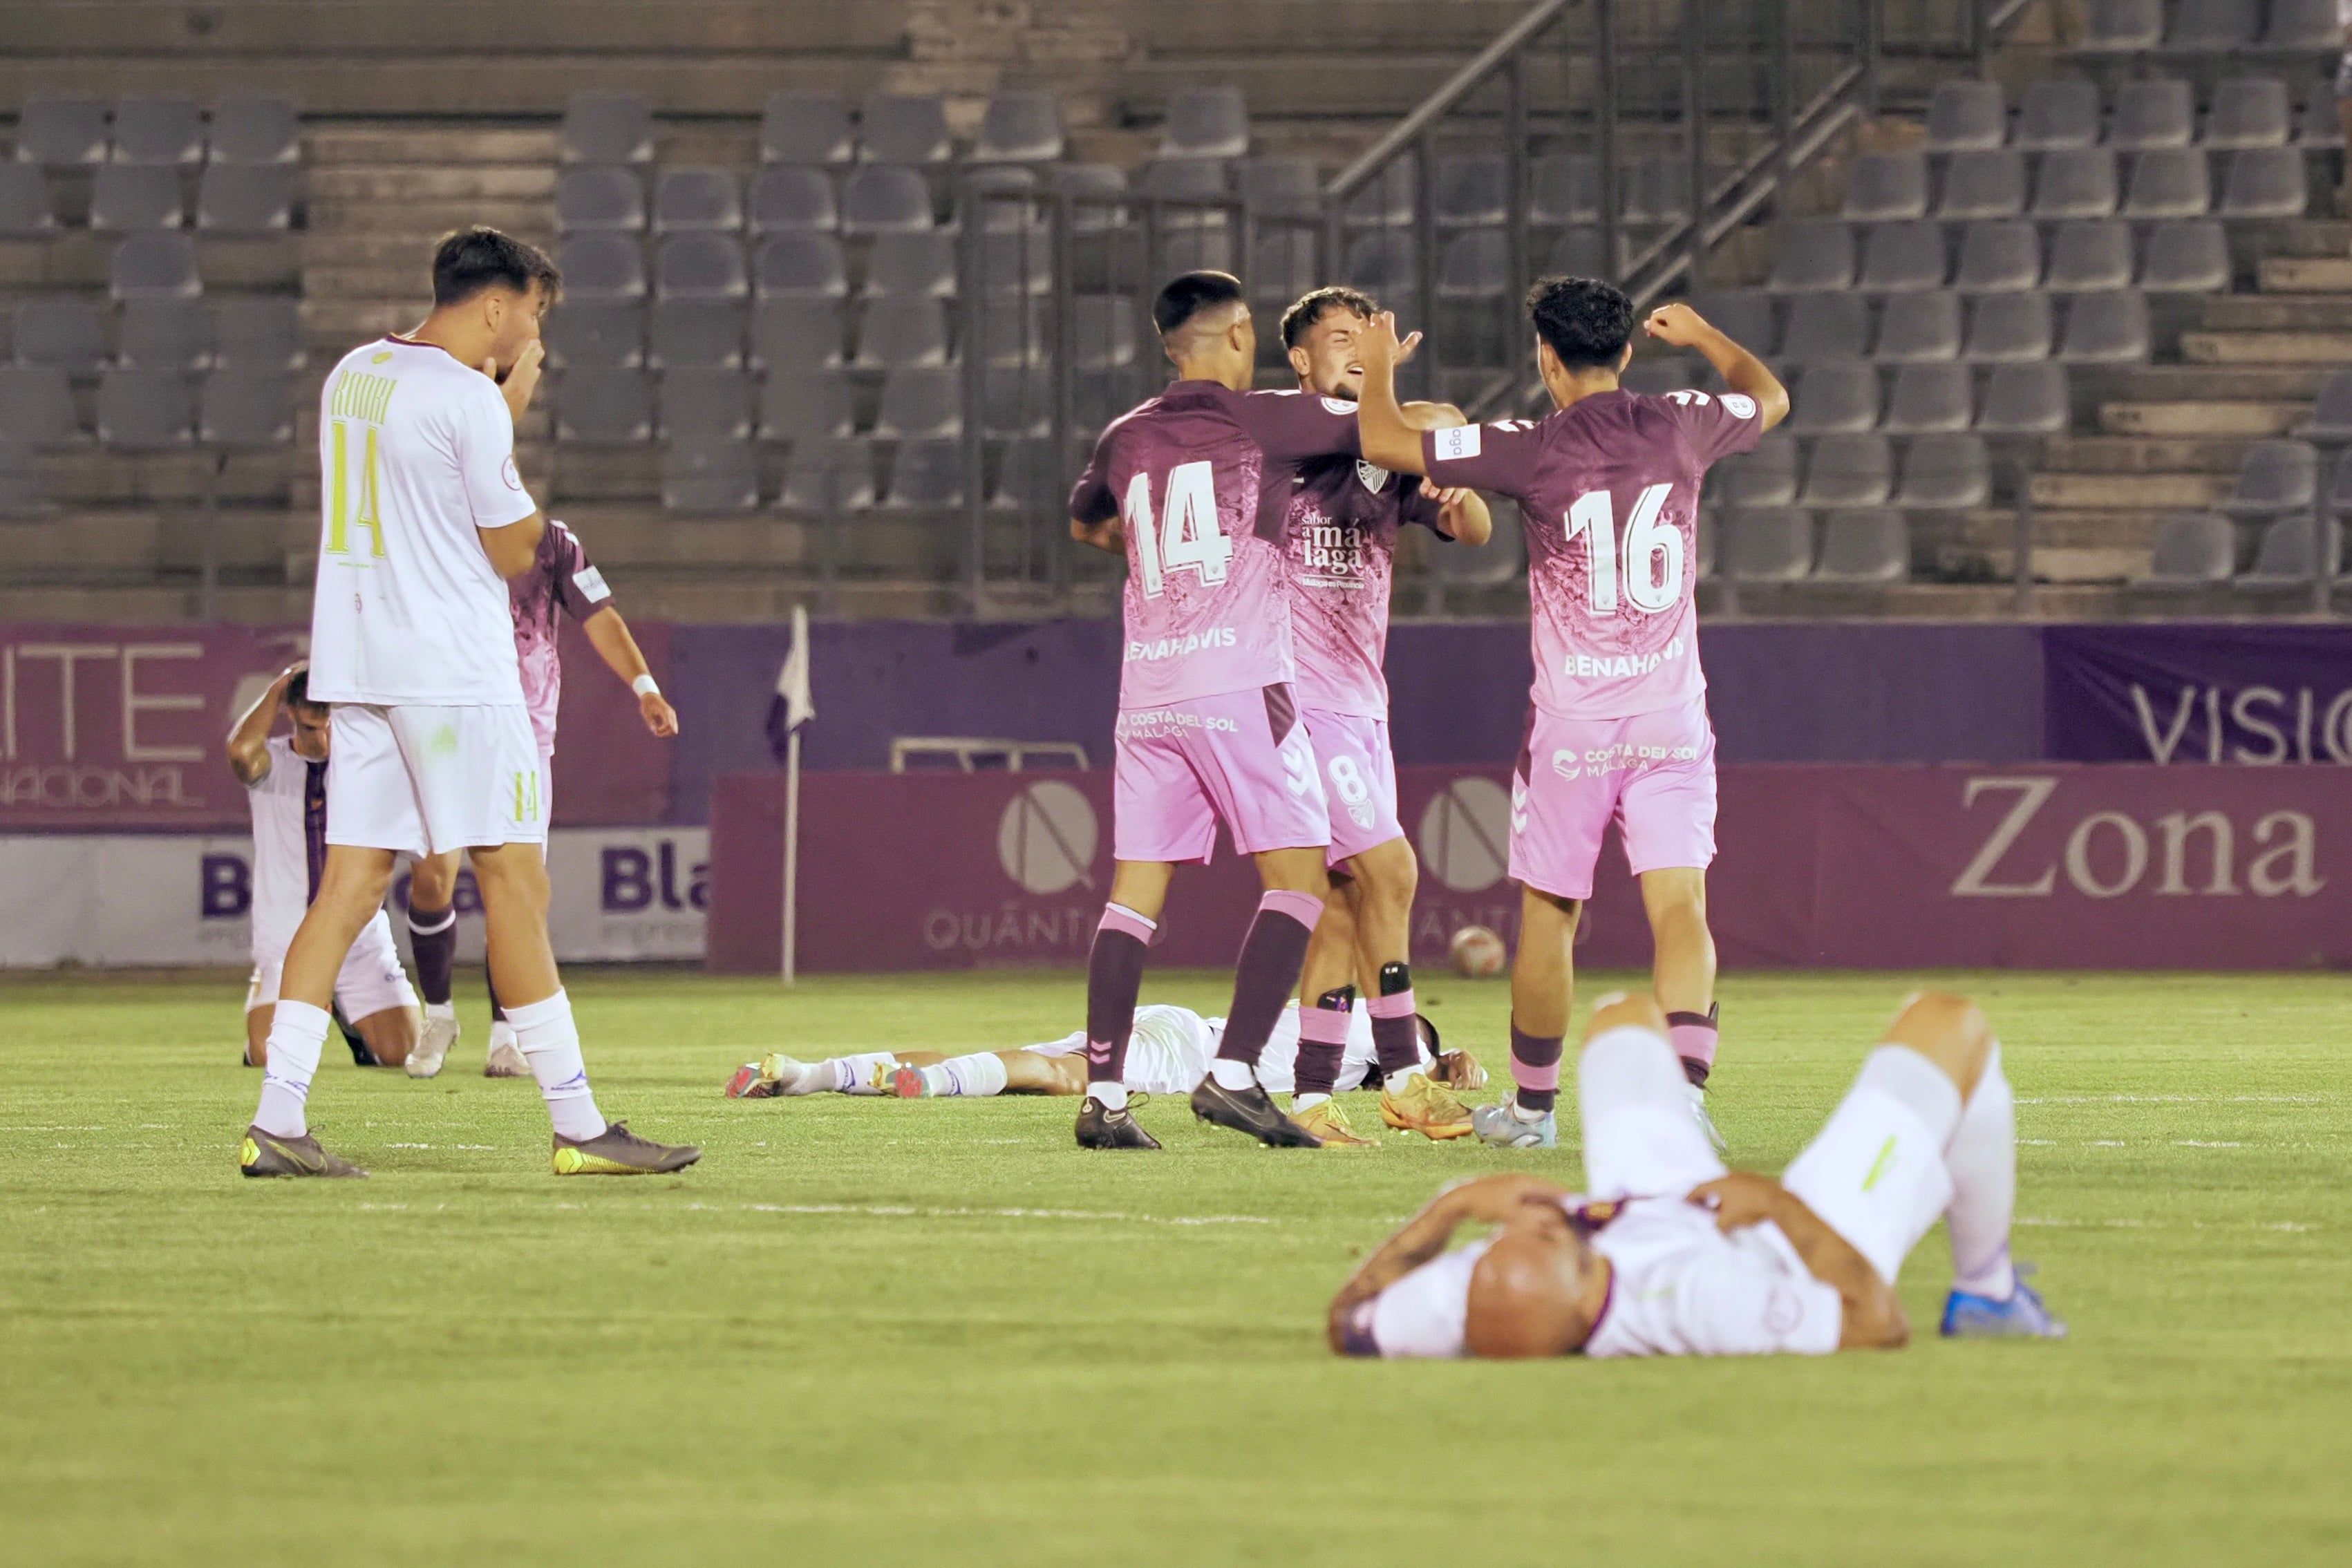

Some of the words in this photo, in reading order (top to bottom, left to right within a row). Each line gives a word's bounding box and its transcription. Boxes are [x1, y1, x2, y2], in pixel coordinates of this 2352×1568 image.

[326, 420, 386, 558] 14
[1123, 460, 1234, 600] 14
[1301, 511, 1333, 525] sabor
[1301, 527, 1311, 538] a
[1303, 539, 1364, 575] laga
[1563, 483, 1685, 616] 16
[1129, 710, 1176, 728] COSTA
[1176, 712, 1205, 728] DEL
[1205, 716, 1240, 733] SOL
[1584, 743, 1633, 764] COSTA
[514, 769, 538, 822] 14
[1328, 755, 1368, 806] 8
[1950, 775, 2327, 898] Zona
